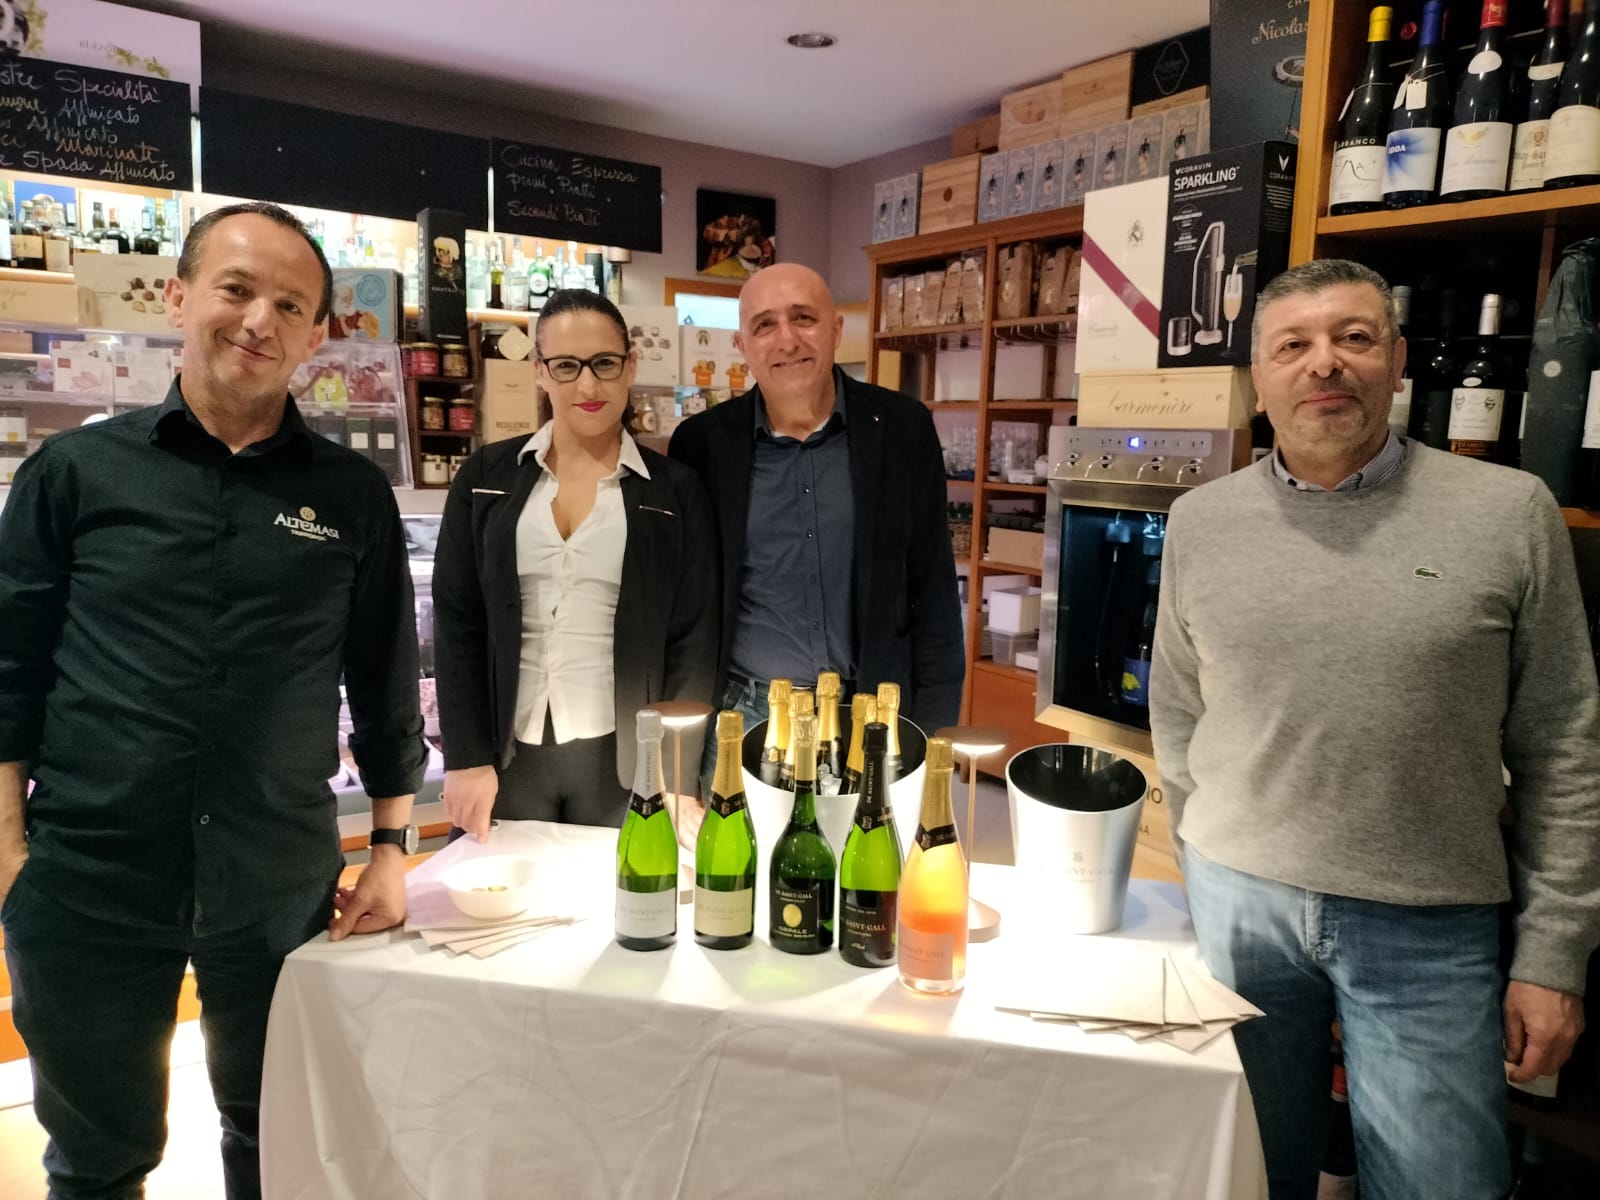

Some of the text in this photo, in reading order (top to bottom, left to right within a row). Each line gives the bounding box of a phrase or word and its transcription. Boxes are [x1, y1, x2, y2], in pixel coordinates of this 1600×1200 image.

[23, 150, 94, 173] Spada
[1181, 162, 1212, 175] CORAVIN
[273, 512, 340, 540] ALTEMASI
